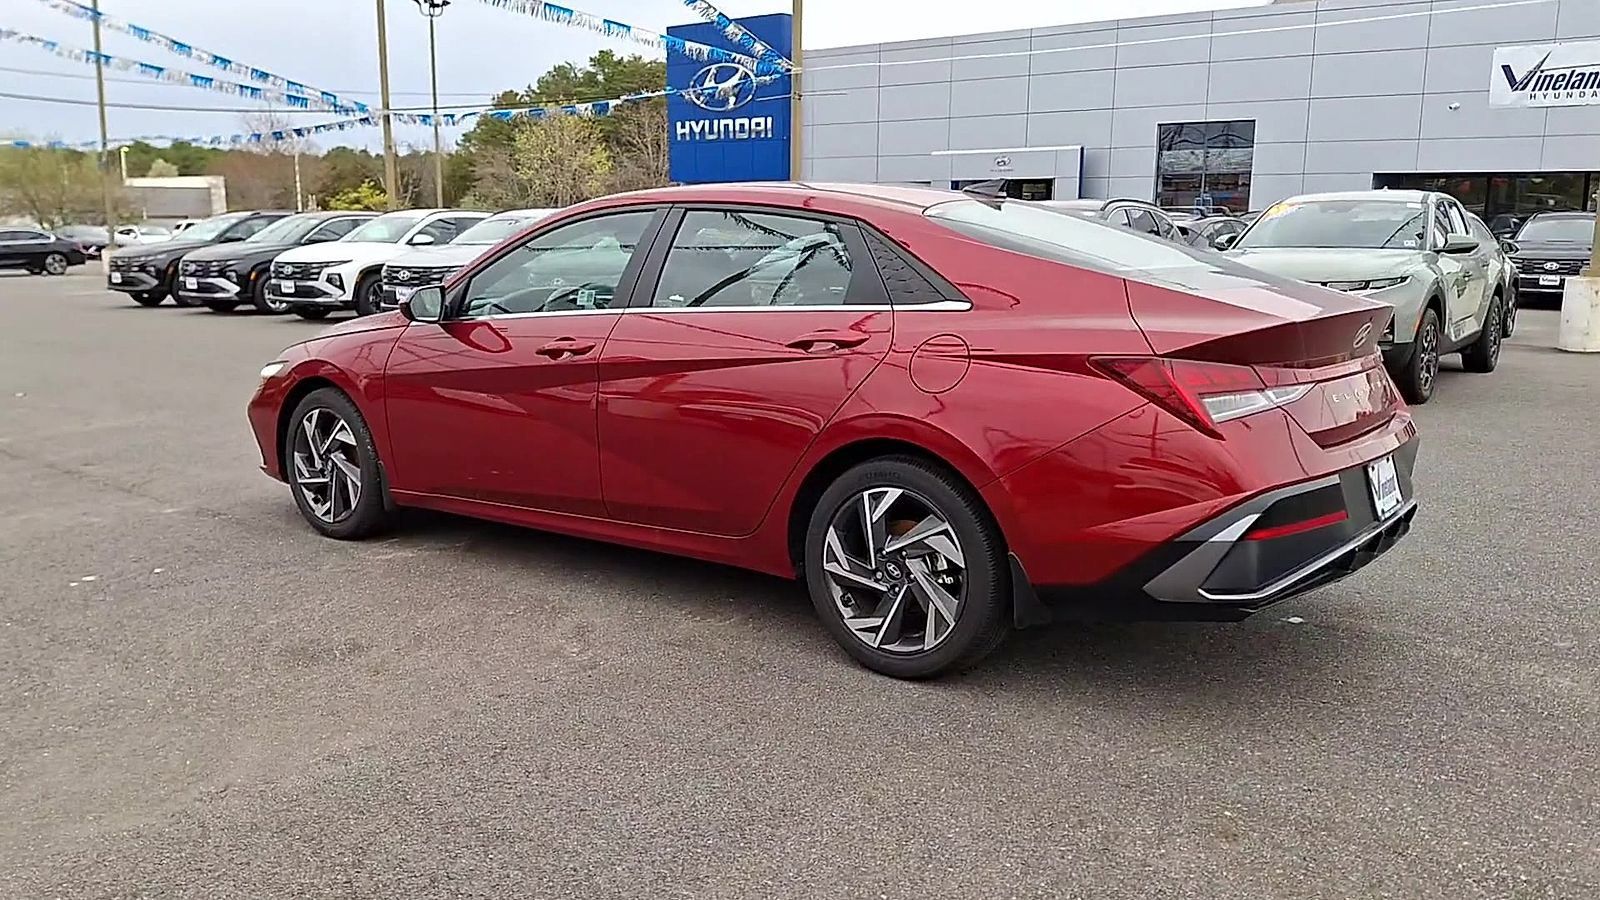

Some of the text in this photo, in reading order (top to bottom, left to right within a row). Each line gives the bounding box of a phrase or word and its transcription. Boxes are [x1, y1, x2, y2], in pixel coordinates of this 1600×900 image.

[1501, 50, 1600, 92] Vinelan
[1529, 90, 1599, 100] HYUNDA
[676, 116, 773, 141] HYUNDAI
